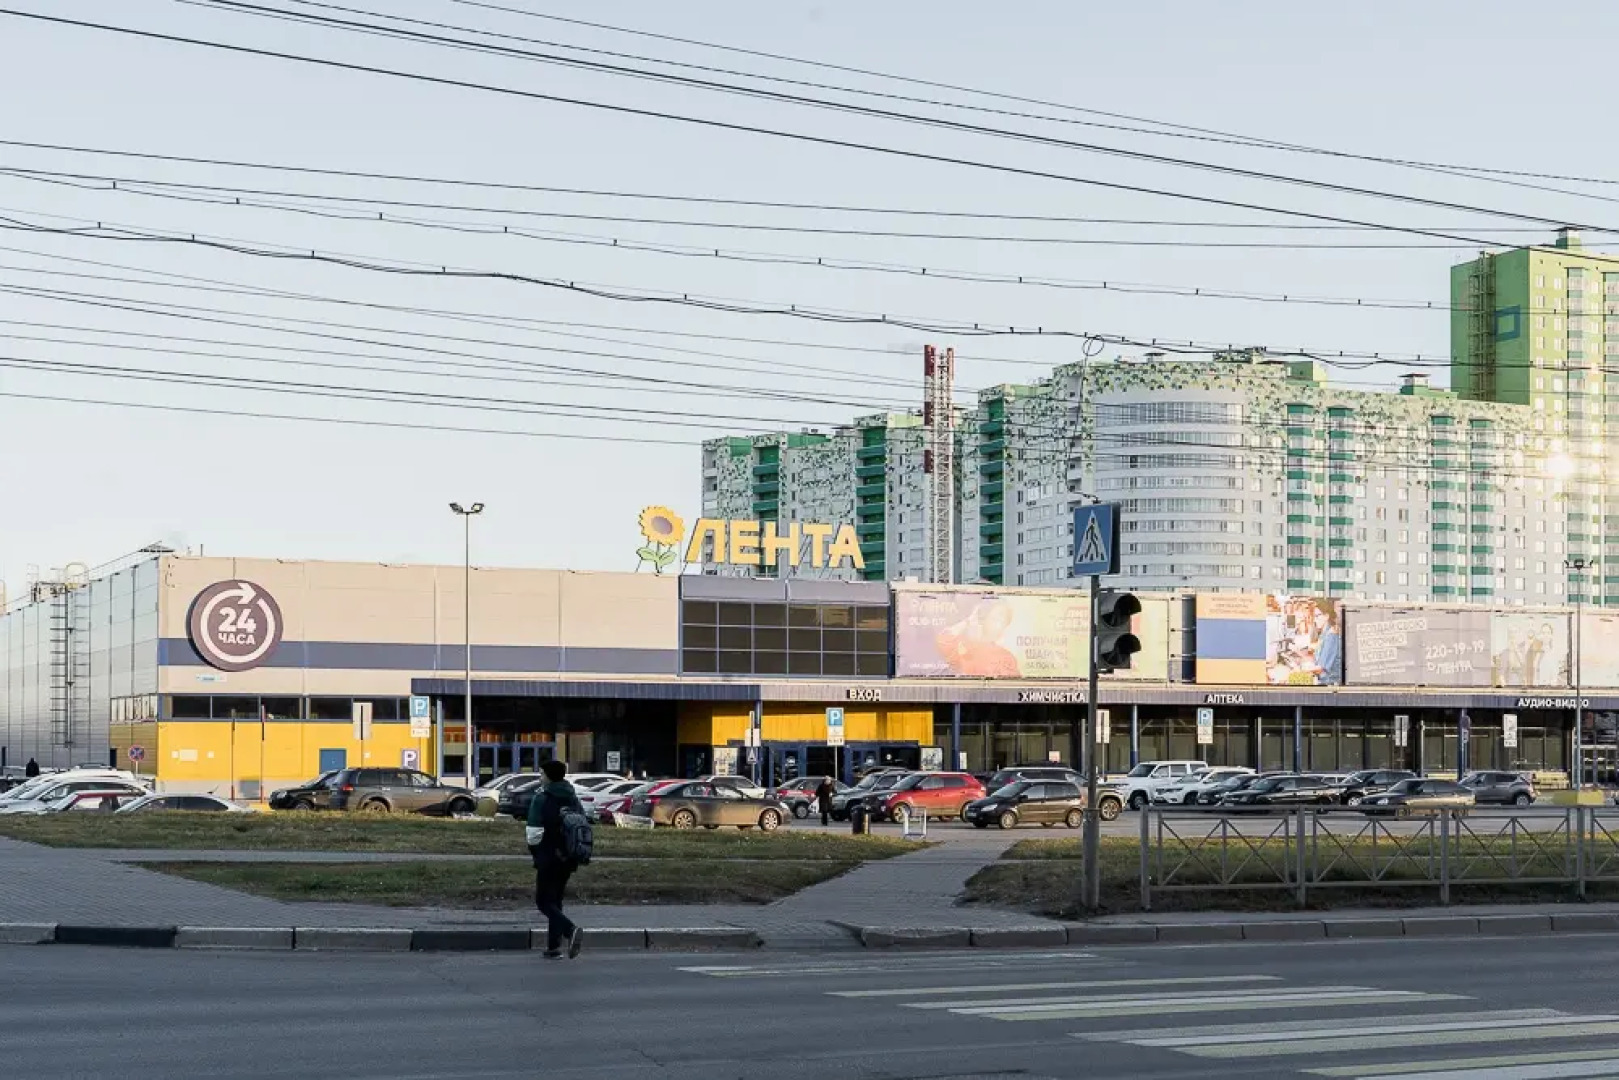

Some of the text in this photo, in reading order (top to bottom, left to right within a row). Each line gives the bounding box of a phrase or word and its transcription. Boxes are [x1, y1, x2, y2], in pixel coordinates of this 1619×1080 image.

[685, 518, 866, 569] ЛЕНТА
[218, 607, 257, 633] 24
[218, 632, 257, 645] ЧАСА
[1425, 639, 1485, 660] 220-19-19
[1436, 660, 1474, 675] ЛЕНТА
[850, 689, 881, 701] ВХОД
[1021, 691, 1085, 703] ХИМЧИСТКА
[1207, 694, 1244, 704] АПТЕКА
[414, 699, 426, 715] P
[830, 710, 841, 725] P
[404, 750, 417, 768] P
